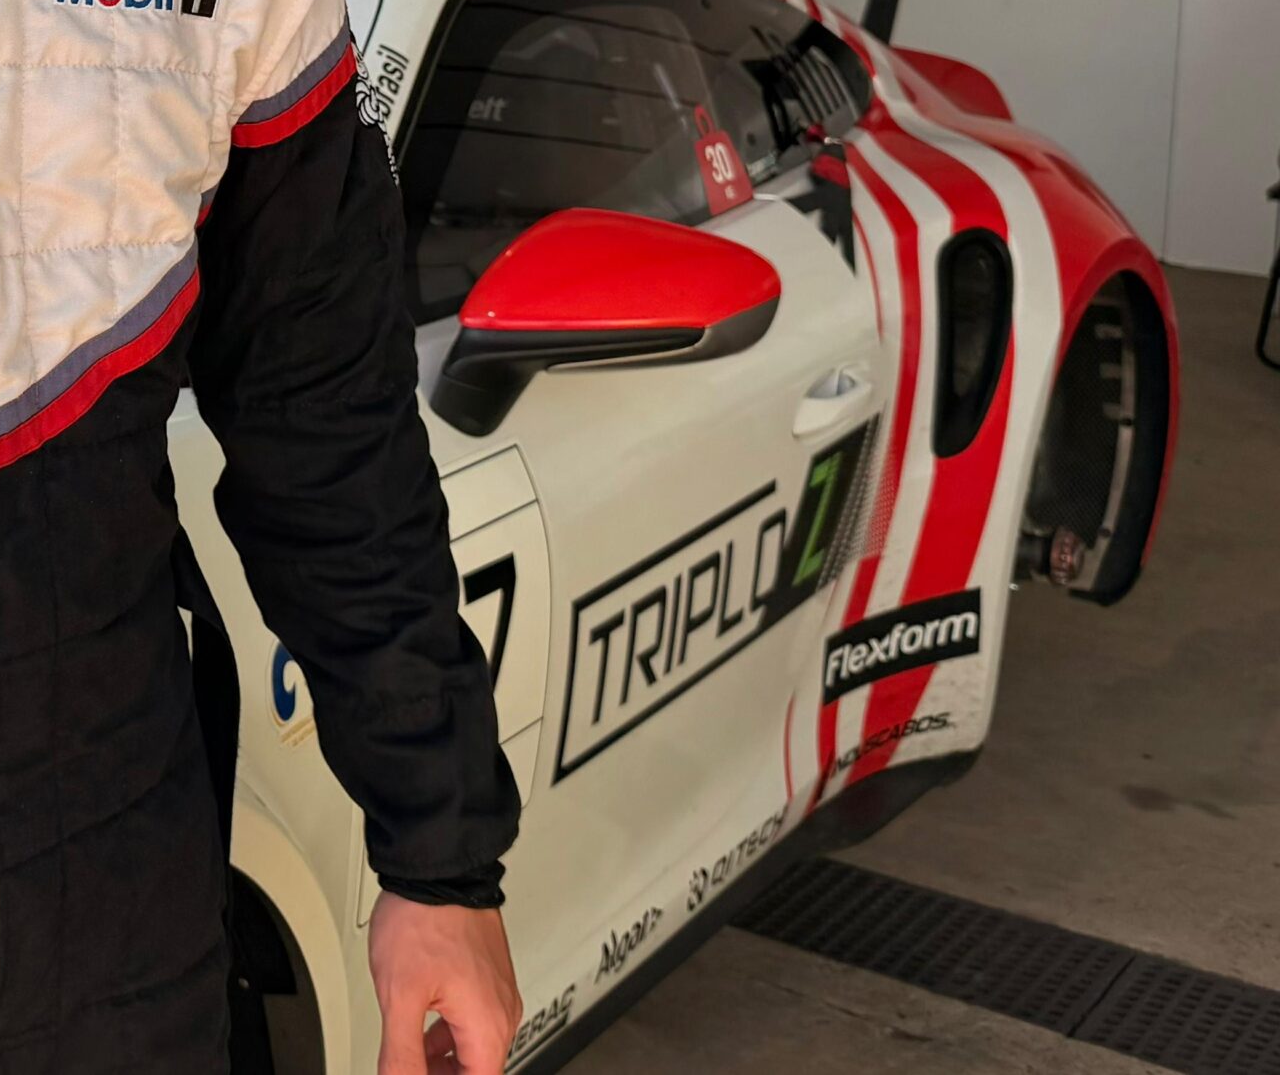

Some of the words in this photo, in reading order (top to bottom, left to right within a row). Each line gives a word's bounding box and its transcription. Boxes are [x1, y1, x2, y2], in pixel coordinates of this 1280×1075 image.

[704, 142, 735, 184] 30
[588, 507, 787, 726] TRIPLO
[825, 611, 979, 687] Flexform
[508, 983, 576, 1057] ERAC
